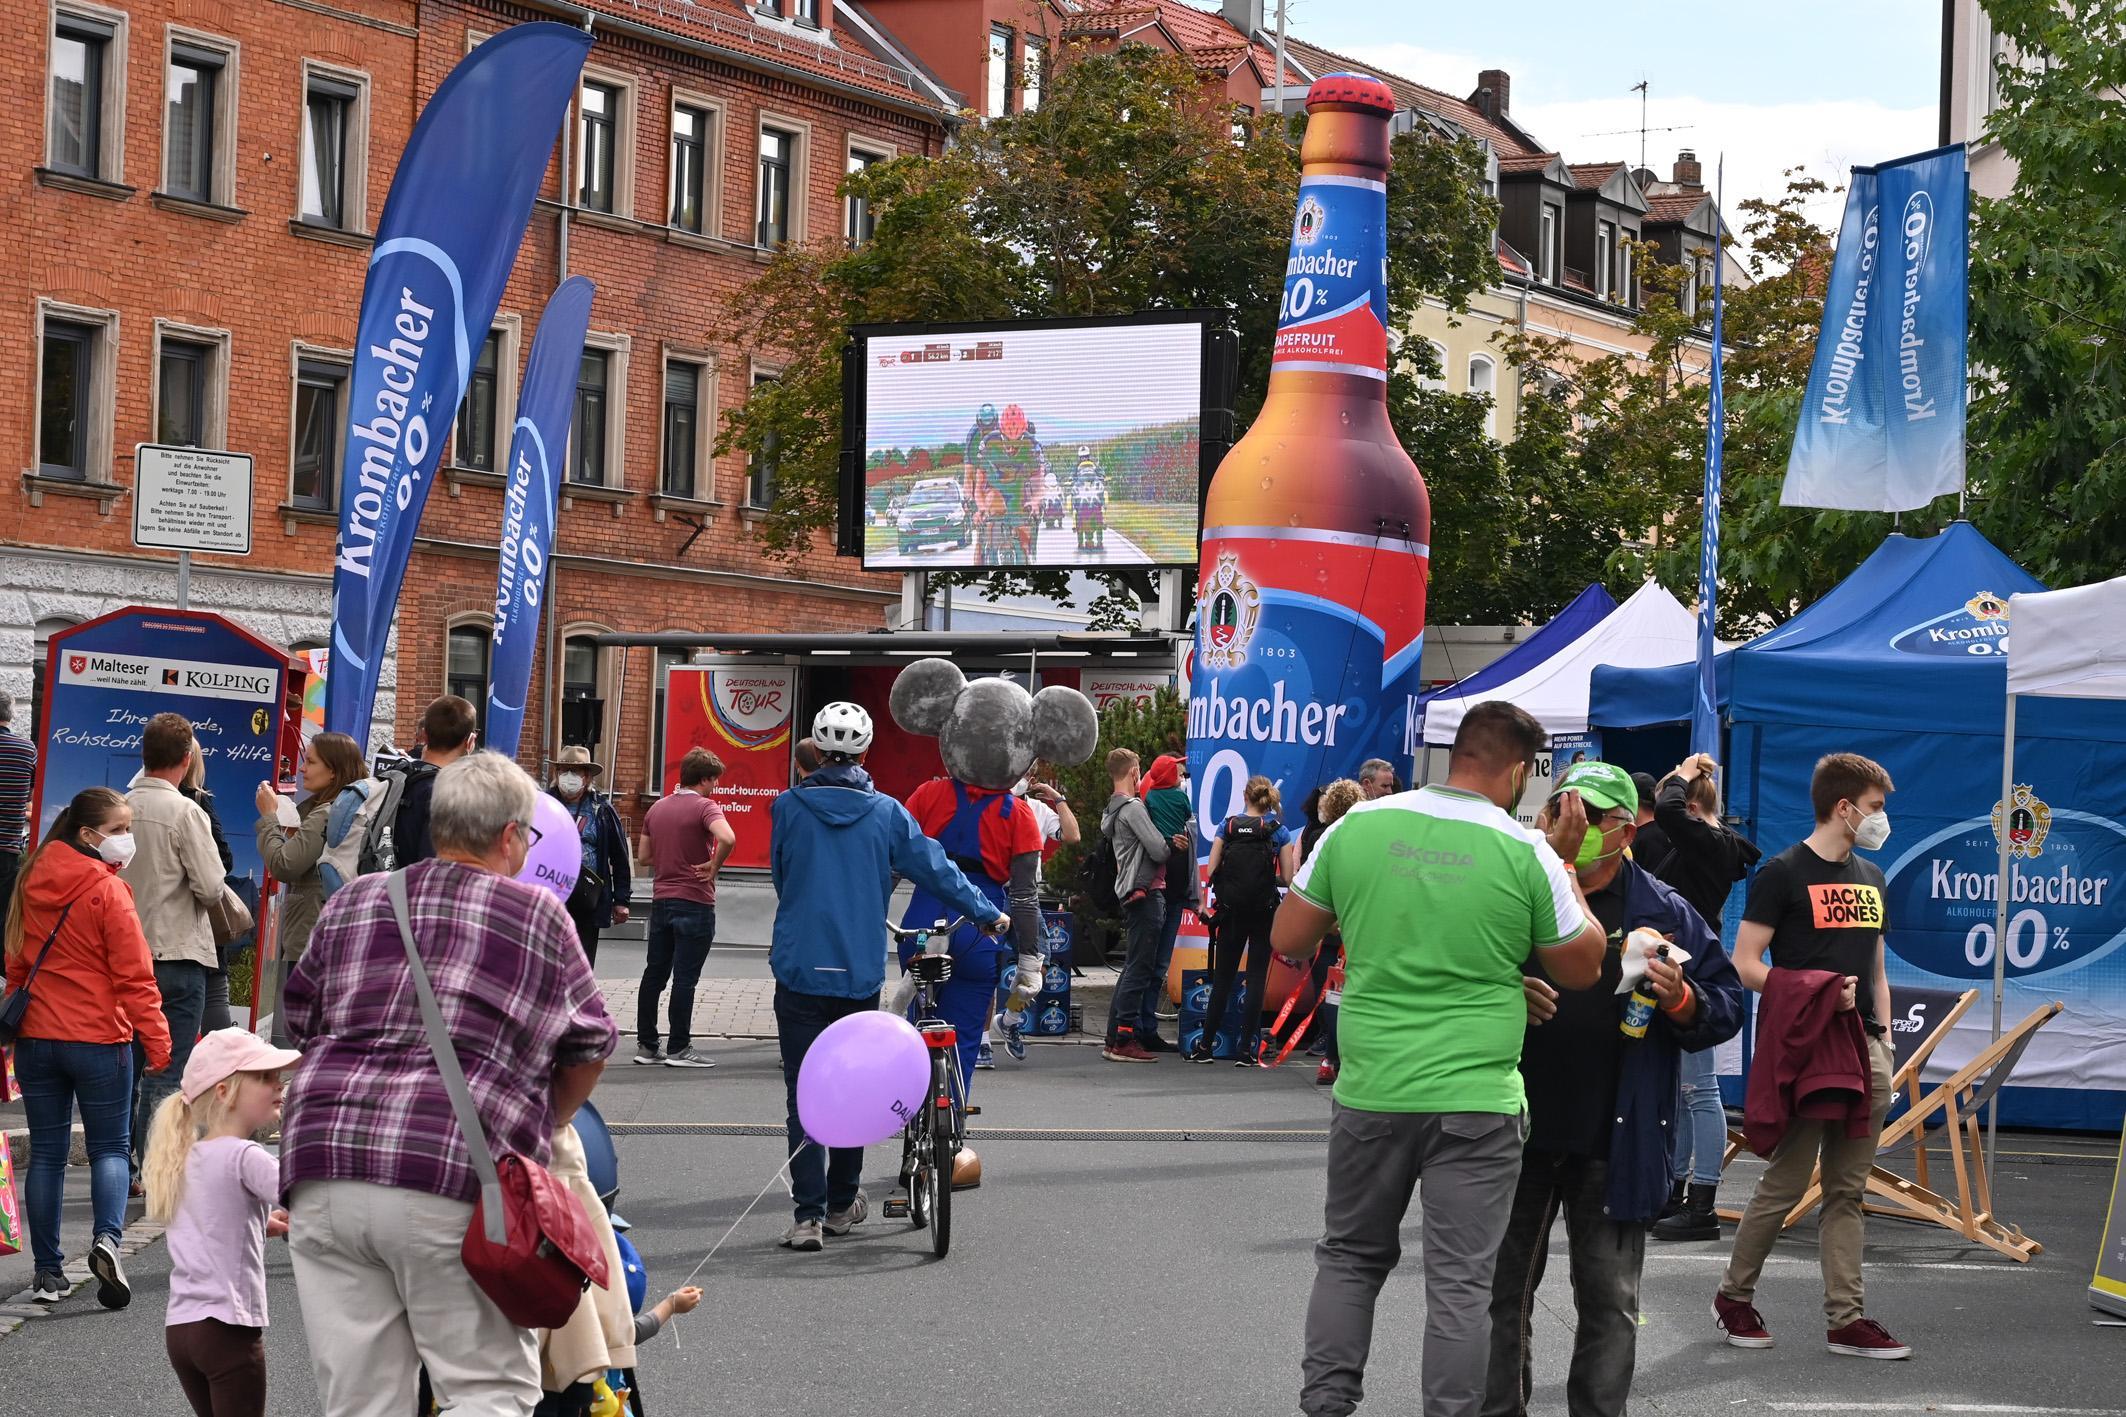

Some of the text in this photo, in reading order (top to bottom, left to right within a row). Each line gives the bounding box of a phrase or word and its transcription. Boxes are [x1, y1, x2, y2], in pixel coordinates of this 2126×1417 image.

[1286, 248, 1358, 279] mbacher
[1287, 347, 1344, 356] ALKOHOLFREI
[341, 286, 435, 579] Krombacher
[174, 453, 194, 461] nehmen
[194, 464, 218, 472] Anwohner
[159, 500, 176, 508] Achten
[377, 458, 403, 545] ALKOHOLFREI
[139, 524, 156, 532] lagern
[1928, 621, 2009, 642] Kromb
[1259, 647, 1296, 659] 1803
[90, 658, 150, 676] Malteser
[111, 677, 129, 686] Nähe
[129, 679, 148, 687] zählt.
[186, 670, 271, 695] KOLPING
[725, 678, 786, 688] DEUTSCHLAND
[1090, 681, 1157, 692] DEUTSCHLAND
[729, 689, 783, 716] TOUR
[1187, 677, 1347, 747] mbacher
[106, 708, 224, 736] Ihre nde,
[51, 727, 144, 750] Rohstoff
[226, 743, 273, 762] Hilfe
[2051, 843, 2076, 851] 1803
[1823, 905, 1880, 923] JONES
[1964, 908, 2071, 969] 00%
